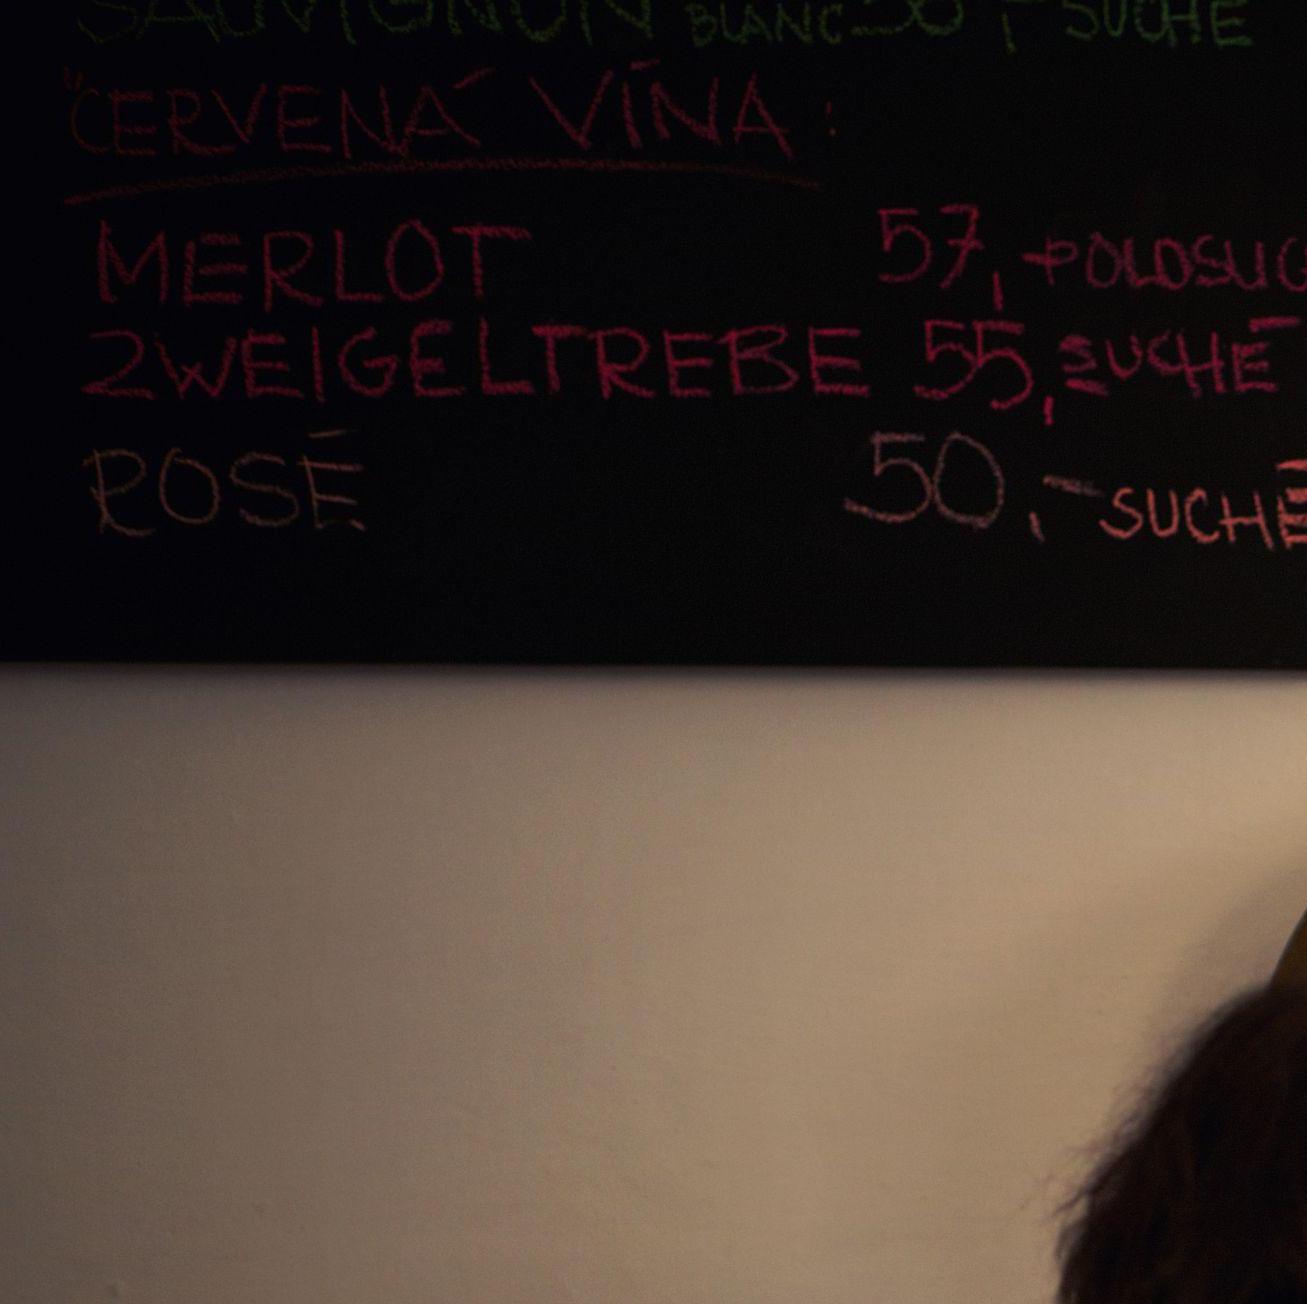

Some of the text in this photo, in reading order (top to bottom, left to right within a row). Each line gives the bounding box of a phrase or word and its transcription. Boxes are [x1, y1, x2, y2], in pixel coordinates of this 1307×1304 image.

[689, 1, 845, 47] BLANC
[98, 219, 532, 311] MERLOT
[83, 429, 366, 537] ROSÉ
